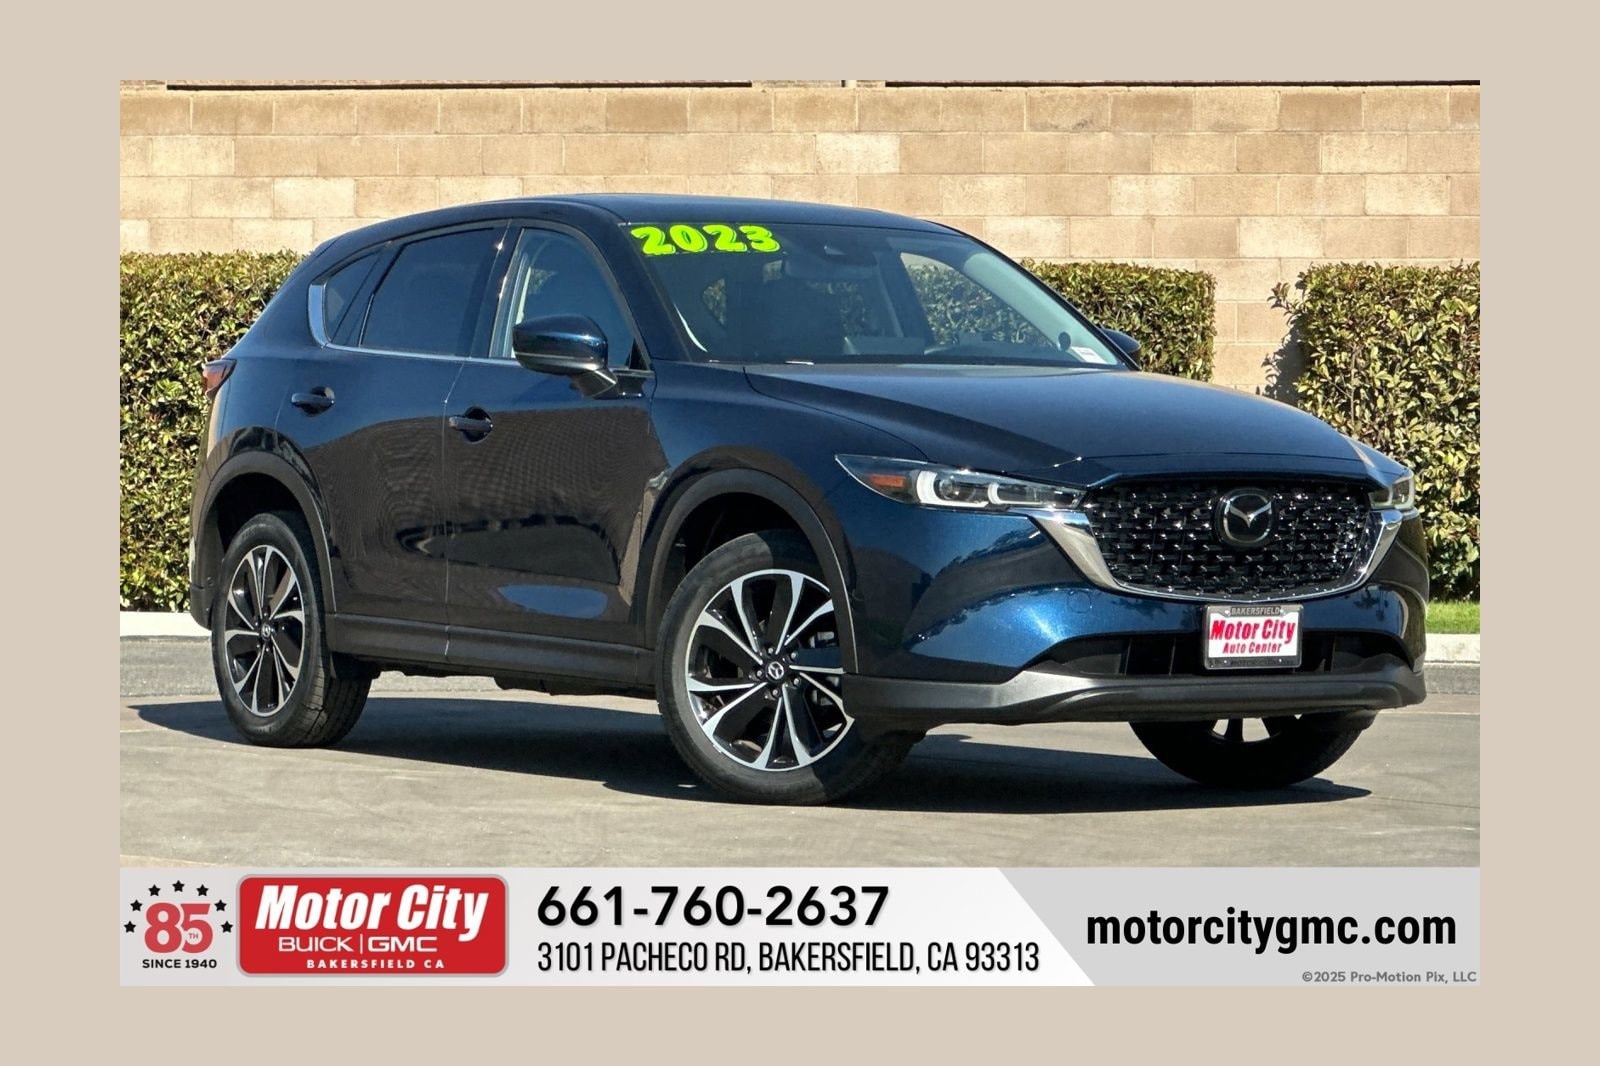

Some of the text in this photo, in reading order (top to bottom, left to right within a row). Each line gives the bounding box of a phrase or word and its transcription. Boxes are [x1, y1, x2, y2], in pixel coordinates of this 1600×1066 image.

[630, 224, 781, 255] 2023
[1231, 606, 1280, 615] BAKERSFIELD
[1210, 619, 1296, 644] Motor City
[1223, 642, 1282, 654] Auto Center
